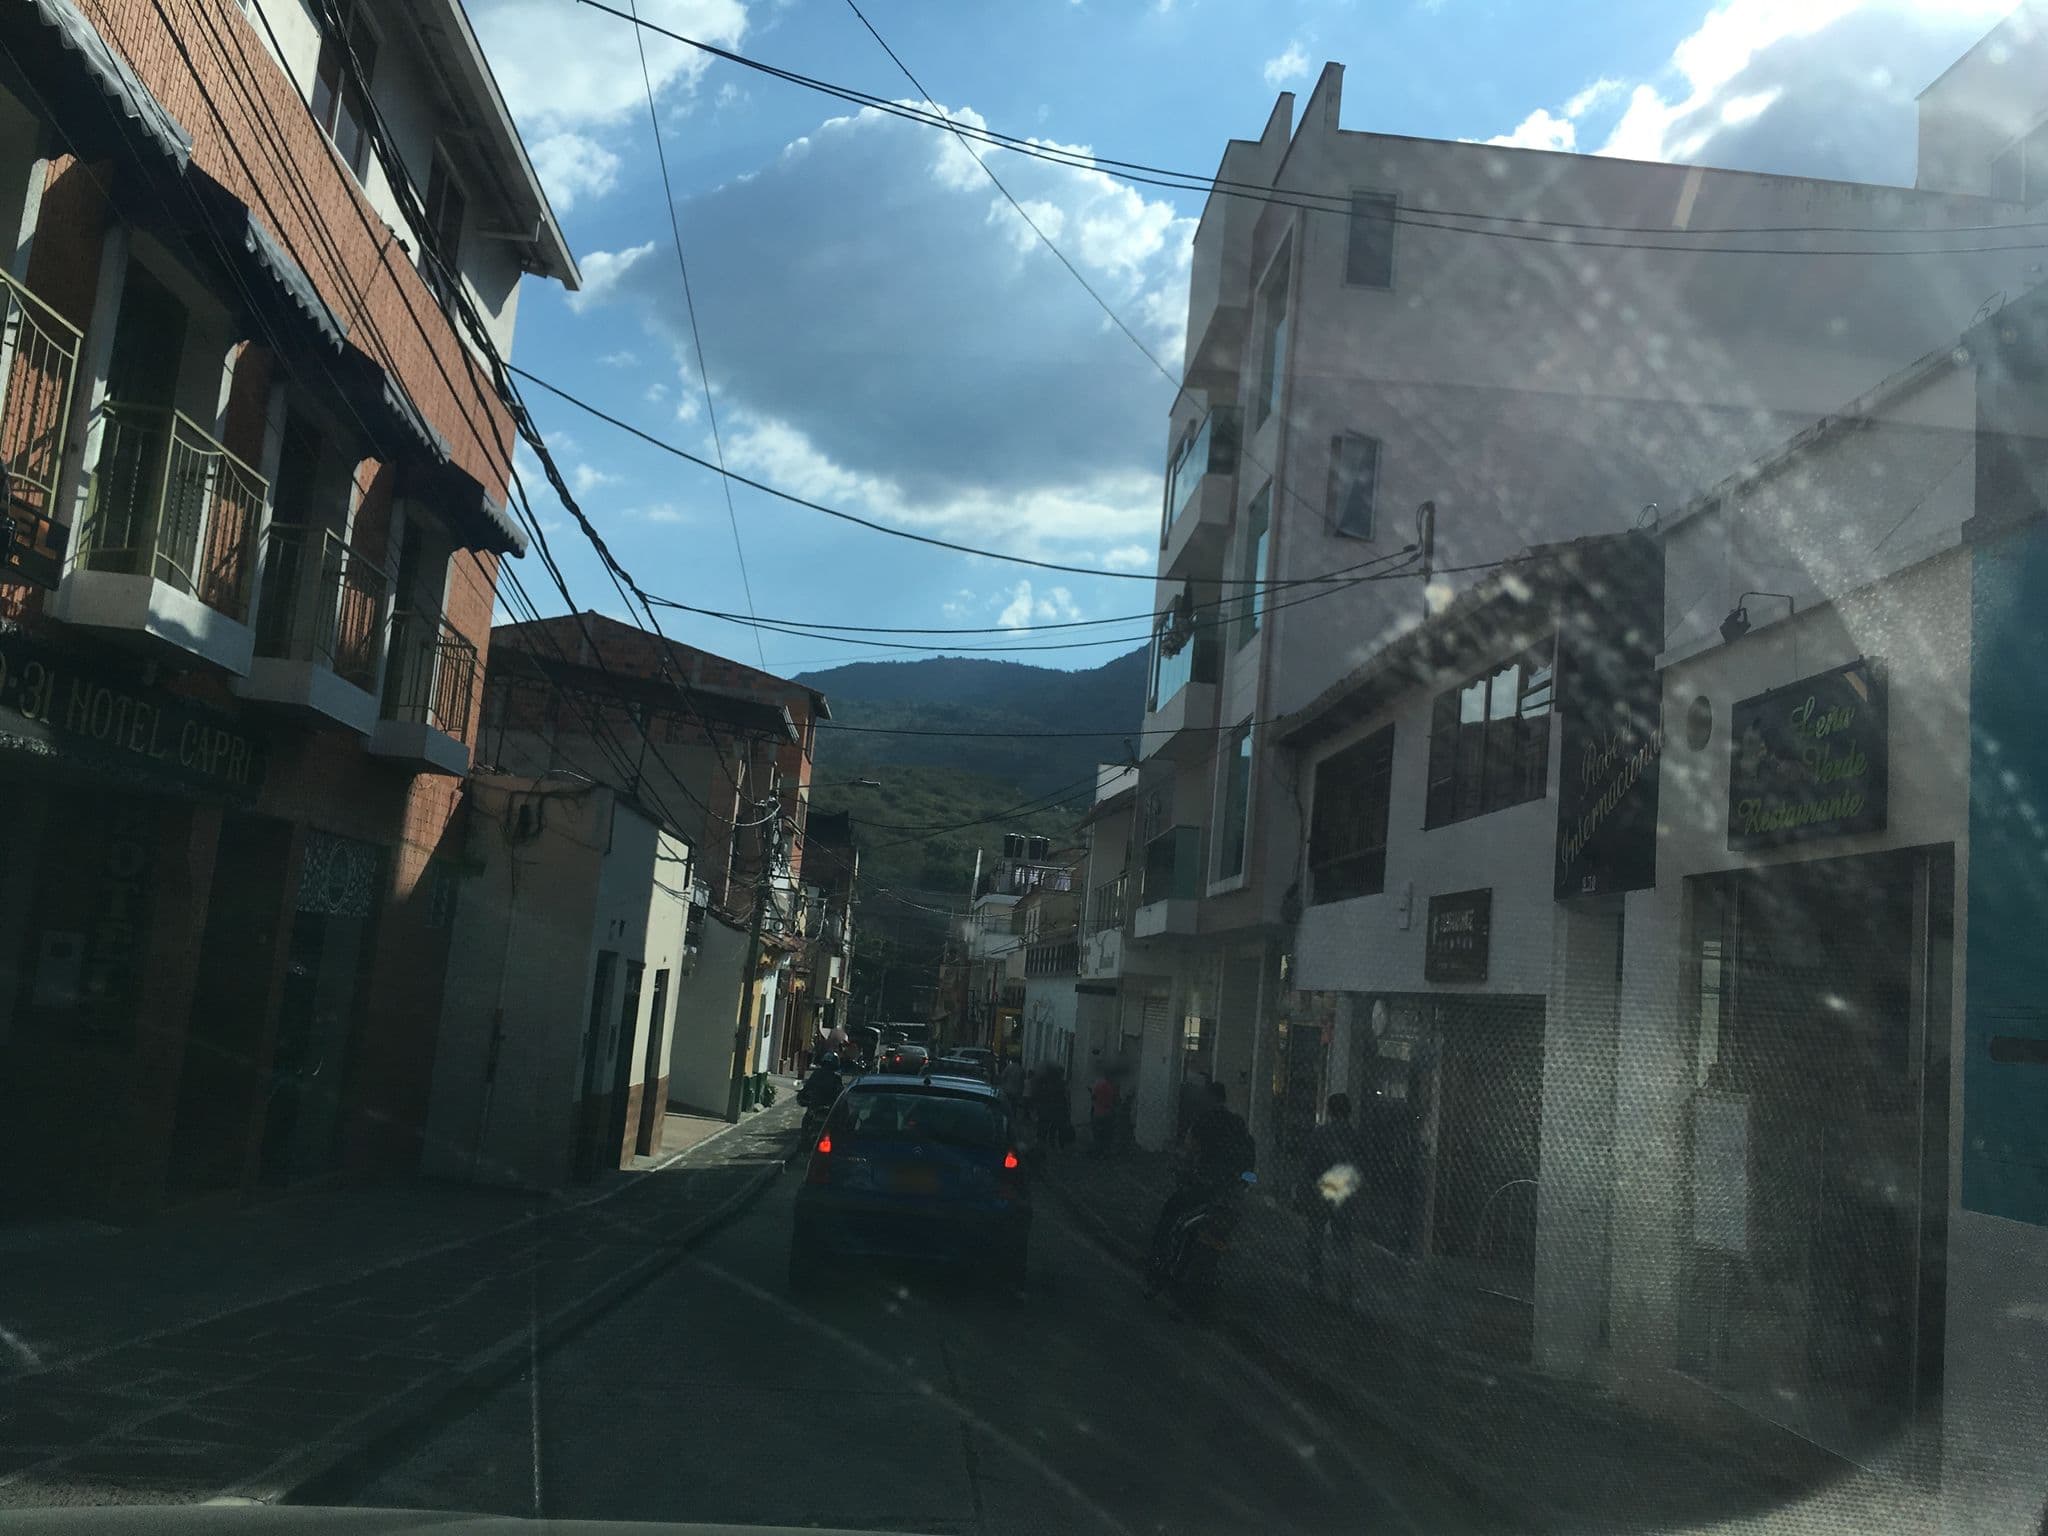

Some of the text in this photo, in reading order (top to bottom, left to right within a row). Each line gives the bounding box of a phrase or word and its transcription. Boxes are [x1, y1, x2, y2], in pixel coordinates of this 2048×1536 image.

[65, 677, 168, 759] HOTEL
[180, 720, 254, 784] CAPRI
[1803, 739, 1868, 783] Verde
[1560, 703, 1665, 885] Internacional
[1738, 790, 1864, 833] Restaurante
